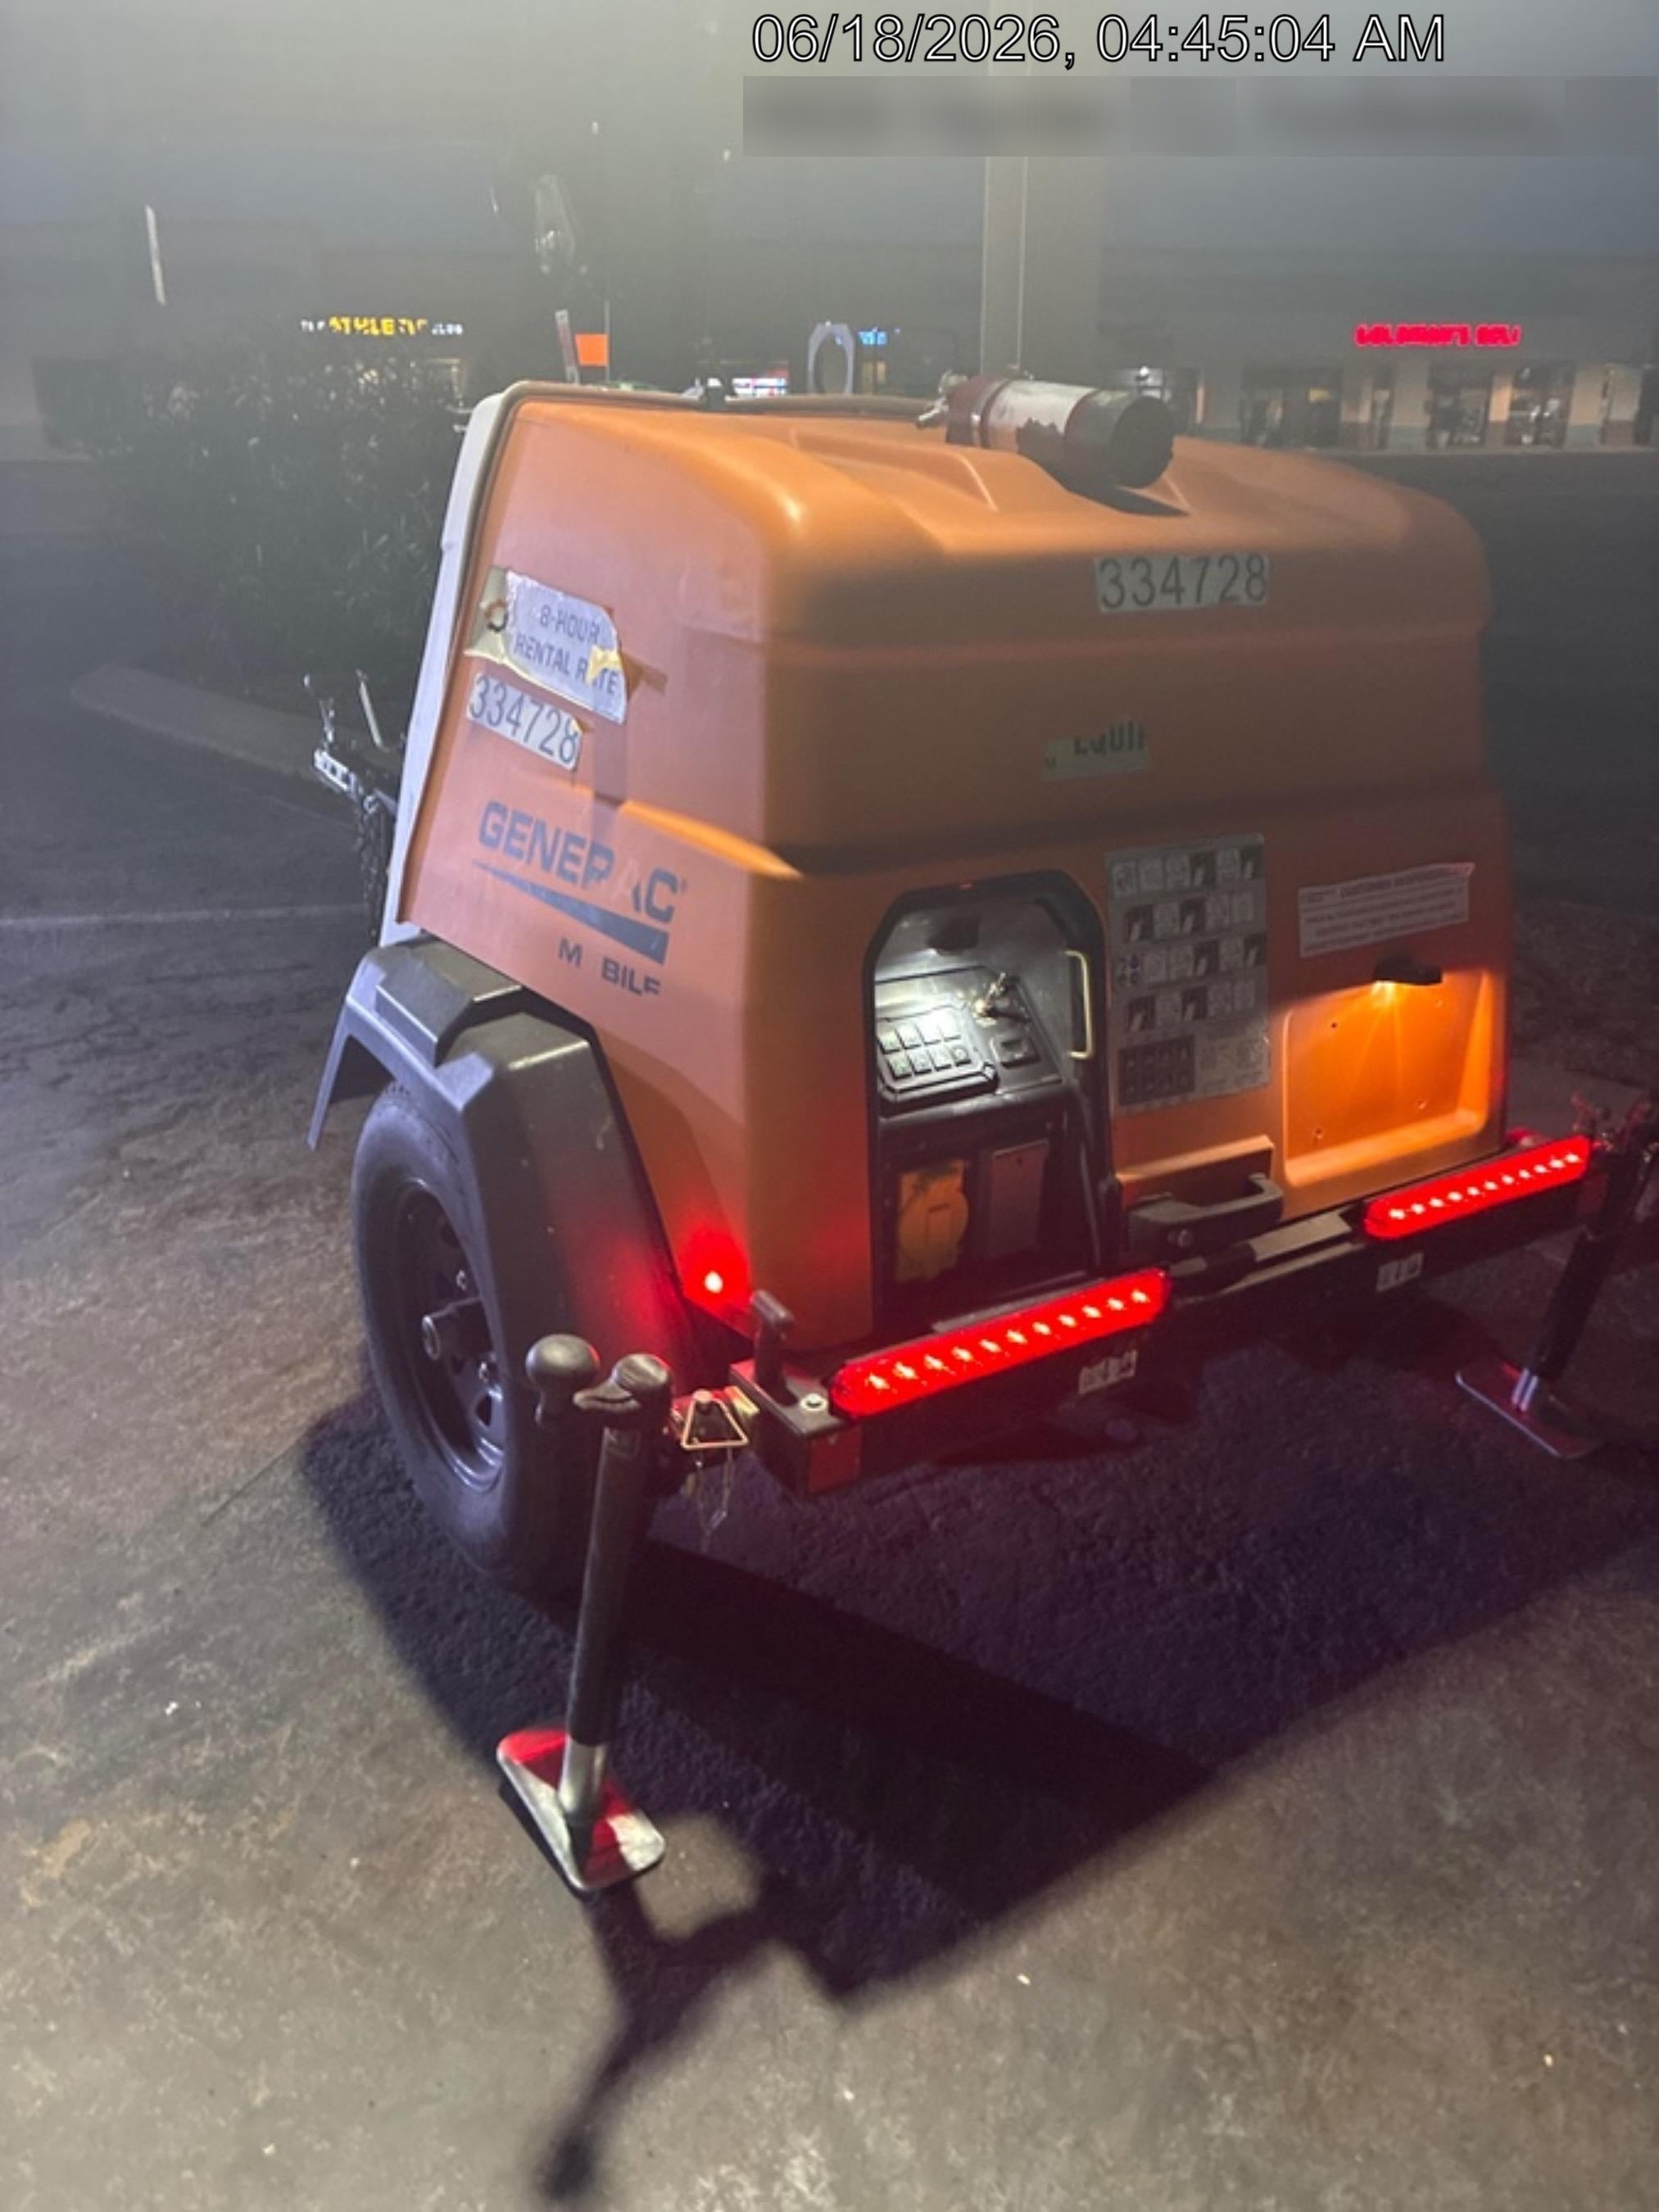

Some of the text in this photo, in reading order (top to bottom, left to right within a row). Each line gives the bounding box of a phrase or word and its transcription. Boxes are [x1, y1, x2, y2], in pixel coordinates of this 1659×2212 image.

[1099, 553, 1267, 609] 334728
[539, 604, 601, 644] 8-HOUR
[514, 632, 619, 695] RENTAL RTE
[469, 674, 577, 764] 334728
[558, 938, 661, 996] MBILE
